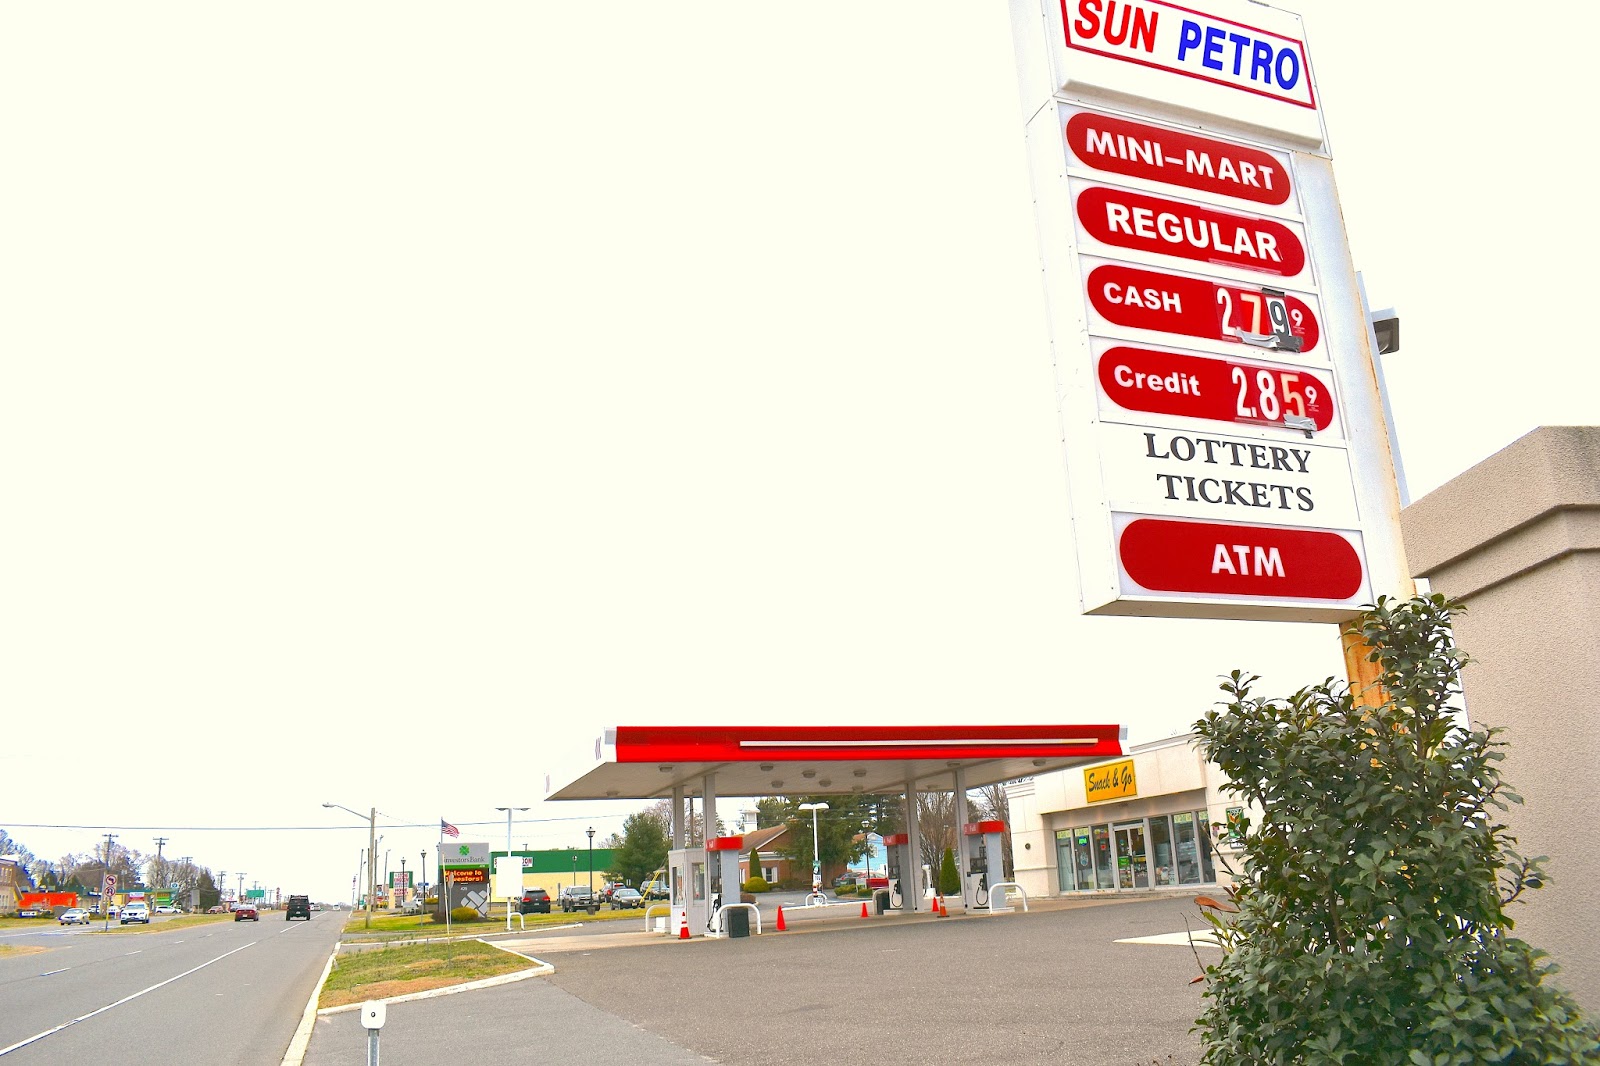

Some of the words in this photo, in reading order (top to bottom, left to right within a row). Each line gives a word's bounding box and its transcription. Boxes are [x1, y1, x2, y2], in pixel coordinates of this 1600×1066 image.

[1074, 0, 1159, 54] SUN
[1177, 19, 1300, 91] PETRO
[1085, 128, 1275, 191] MINI-MART
[1105, 202, 1283, 263] REGULAR
[1102, 282, 1183, 314] CASH
[1113, 365, 1202, 397] Credit
[1143, 432, 1311, 473] LOTTERY
[1156, 473, 1315, 512] TICKETS
[1211, 543, 1286, 578] ATM
[1088, 770, 1111, 793] Snack
[1112, 767, 1119, 788] &
[1121, 765, 1133, 793] Go
